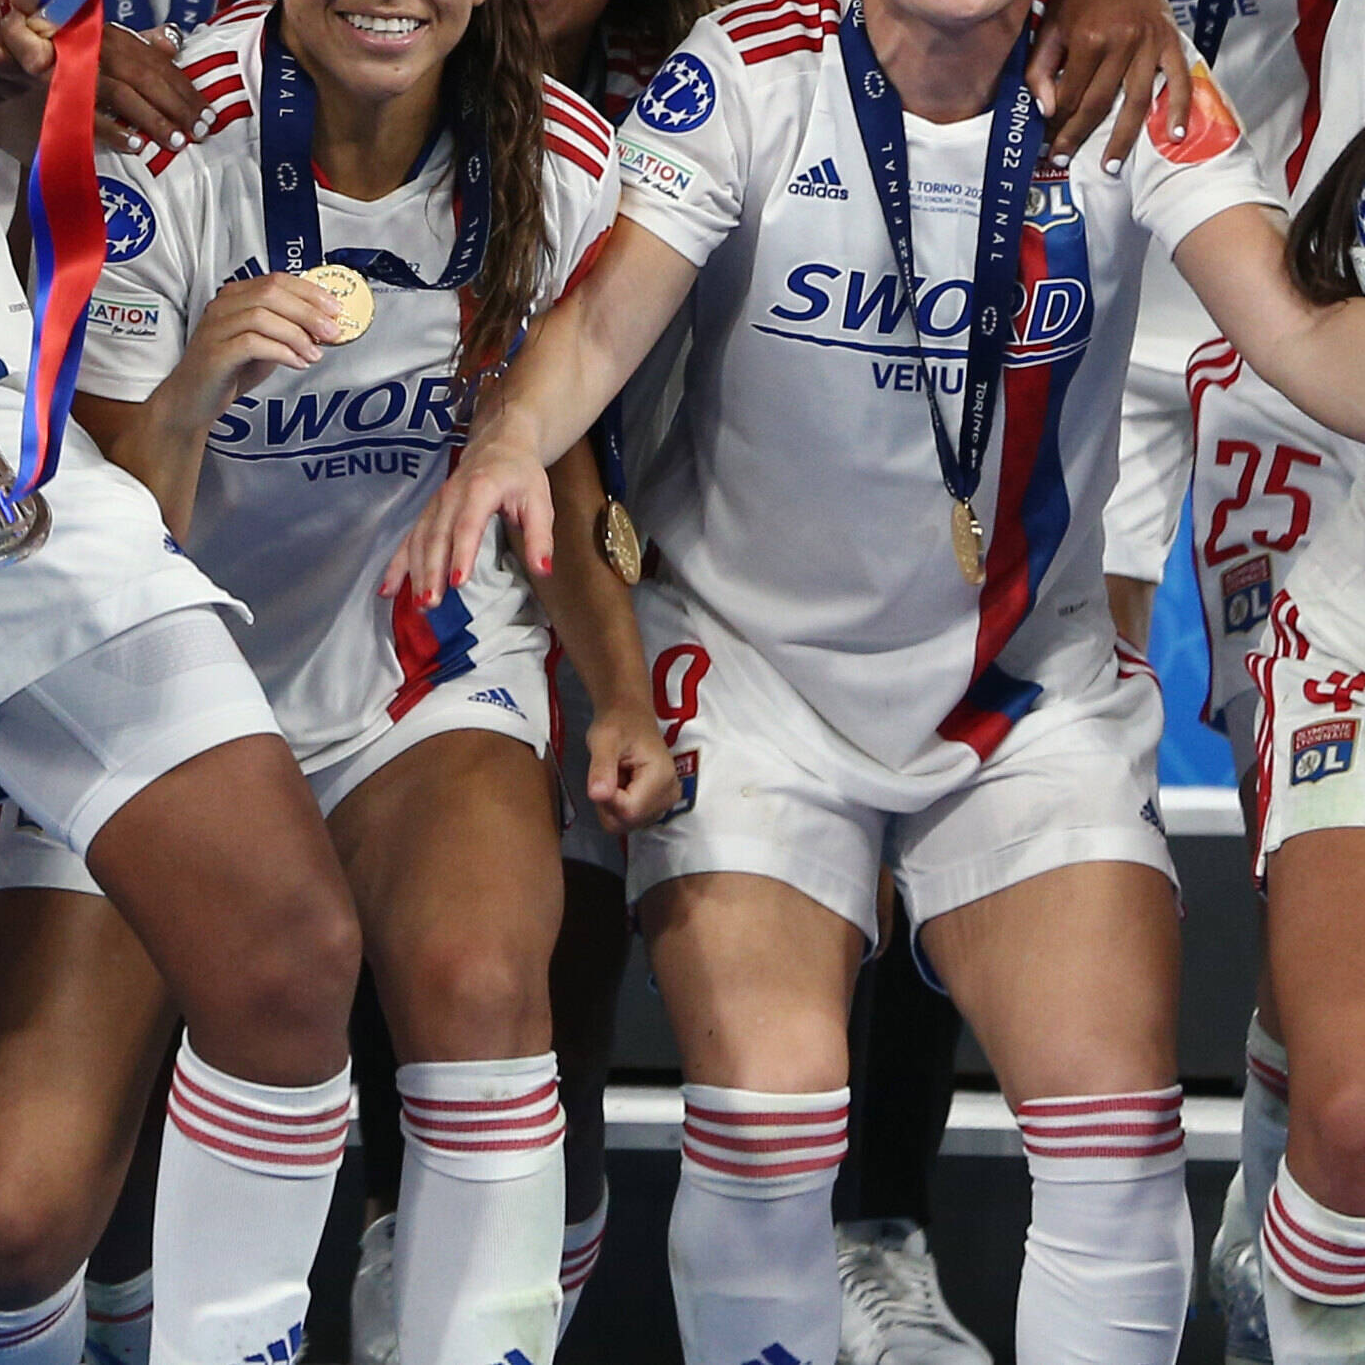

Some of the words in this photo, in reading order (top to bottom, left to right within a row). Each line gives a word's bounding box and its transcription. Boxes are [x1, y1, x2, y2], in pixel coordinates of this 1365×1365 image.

[279, 55, 296, 117] INAL
[1003, 147, 1022, 168] 22
[788, 182, 849, 201] adidas
[917, 181, 962, 195] TORINO
[1024, 185, 1074, 216] OL
[991, 180, 1013, 262] FINAL
[89, 304, 159, 325] ATION
[871, 361, 964, 395] VENU
[210, 376, 457, 446] SWOR
[972, 381, 988, 445] TORINO
[301, 452, 420, 482] VENUE
[1204, 439, 1322, 567] 25
[1296, 745, 1345, 779] OL
